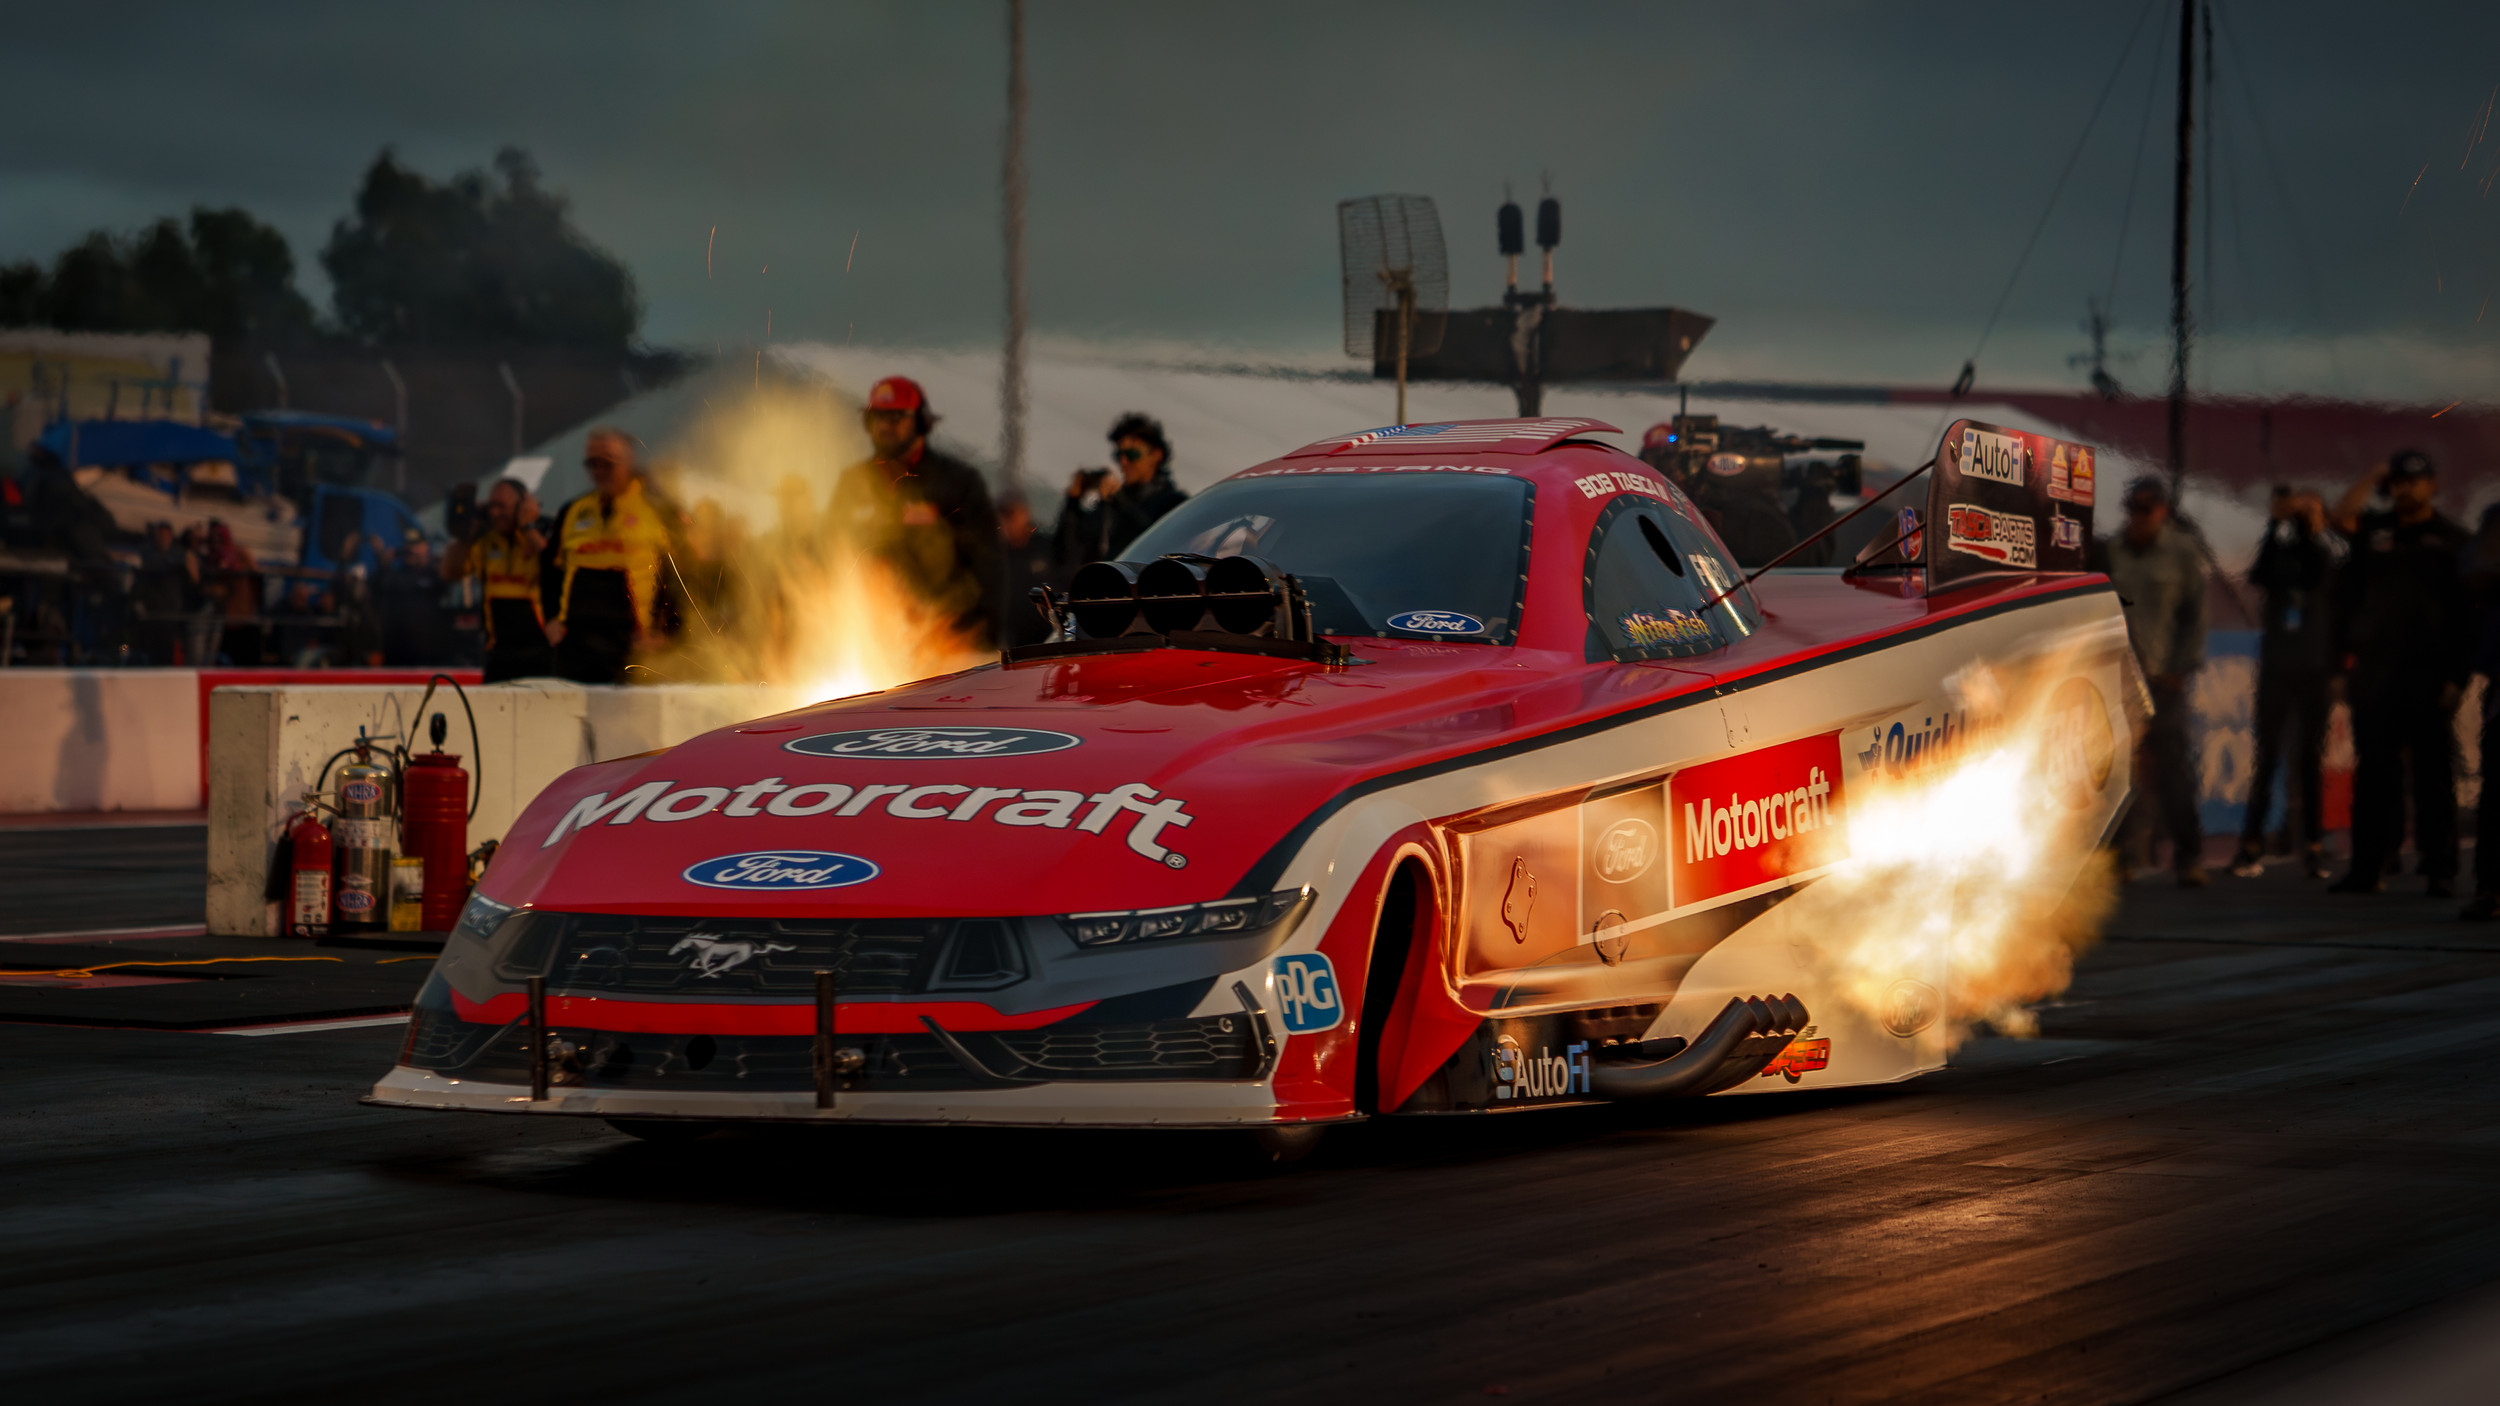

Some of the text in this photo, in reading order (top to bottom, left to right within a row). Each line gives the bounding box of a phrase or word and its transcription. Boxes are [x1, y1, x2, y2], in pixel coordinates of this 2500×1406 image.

[1236, 465, 1512, 479] MUSTANG
[1971, 433, 2023, 482] AutoFi
[1574, 473, 1617, 499] BOB
[1406, 613, 1466, 631] Ford
[833, 730, 1029, 754] Ford
[1684, 766, 1833, 864] Motorcraft
[716, 855, 845, 885] Ford
[1605, 827, 1648, 876] Ford
[1275, 961, 1336, 1025] PPG
[1512, 1040, 1591, 1099] AutoFi
